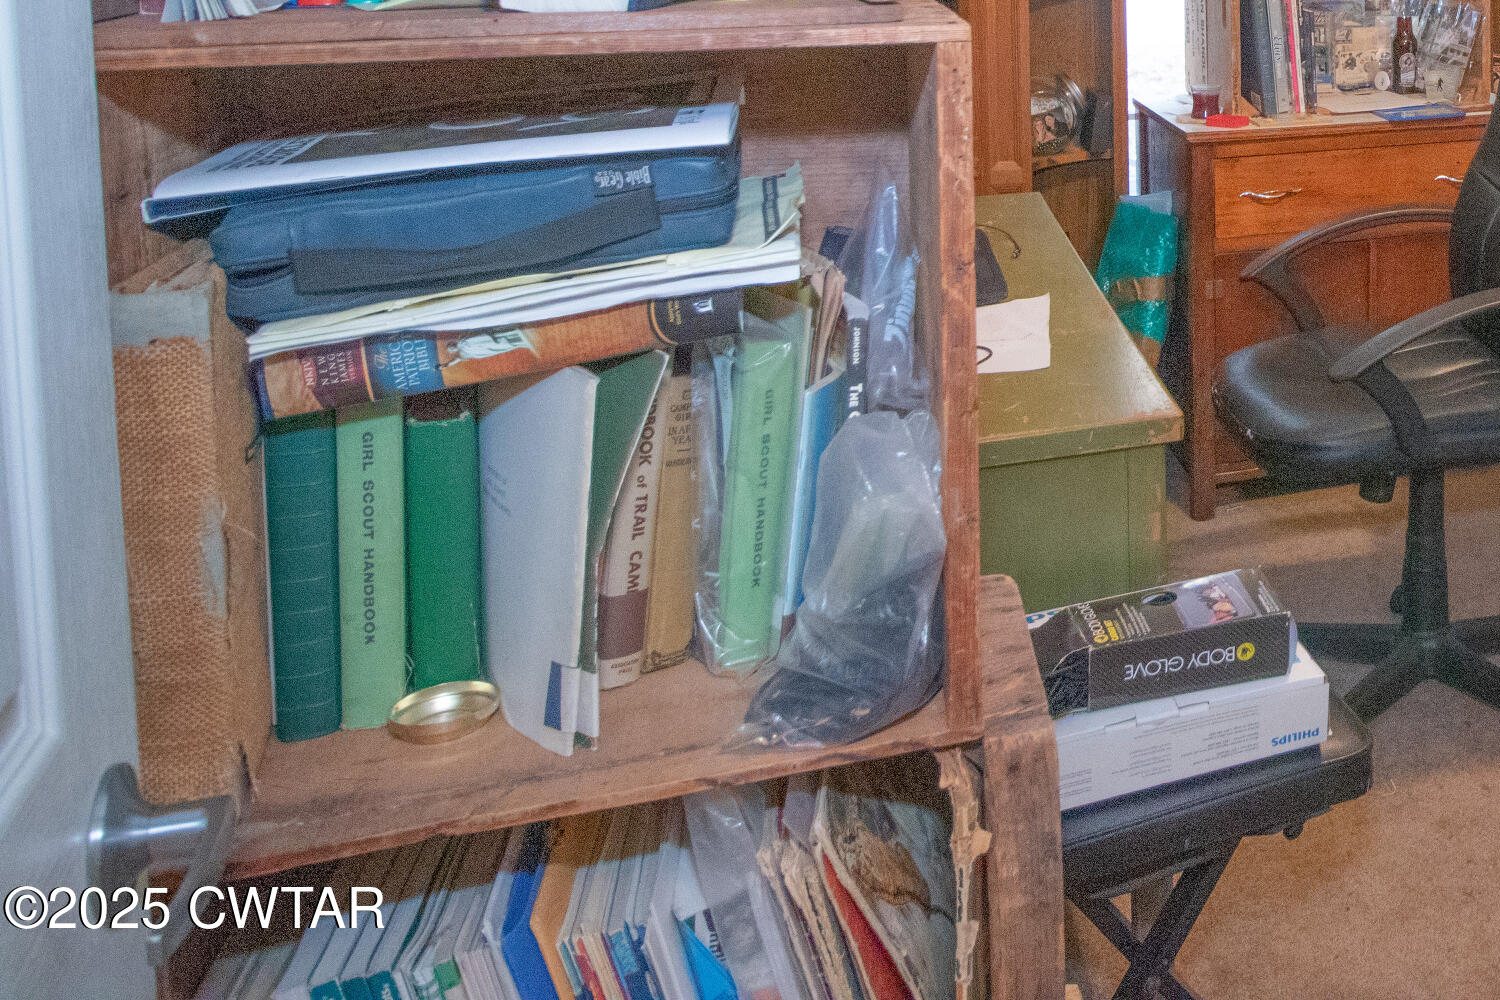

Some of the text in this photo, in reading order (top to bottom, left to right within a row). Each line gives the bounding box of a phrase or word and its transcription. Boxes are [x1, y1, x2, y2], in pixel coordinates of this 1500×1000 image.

[317, 354, 329, 386] NEW
[327, 353, 340, 385] KING
[337, 351, 349, 383] JAMES
[372, 347, 390, 371] The
[757, 433, 772, 489] SCOUT
[636, 474, 648, 489] of
[631, 493, 649, 541] TRAIL
[361, 431, 376, 645] GIRL SCOUT HANDBOOK
[751, 496, 766, 590] HANDBOOK
[1123, 645, 1236, 681] BODY GLOVE
[1271, 727, 1320, 747] PHILIPS
